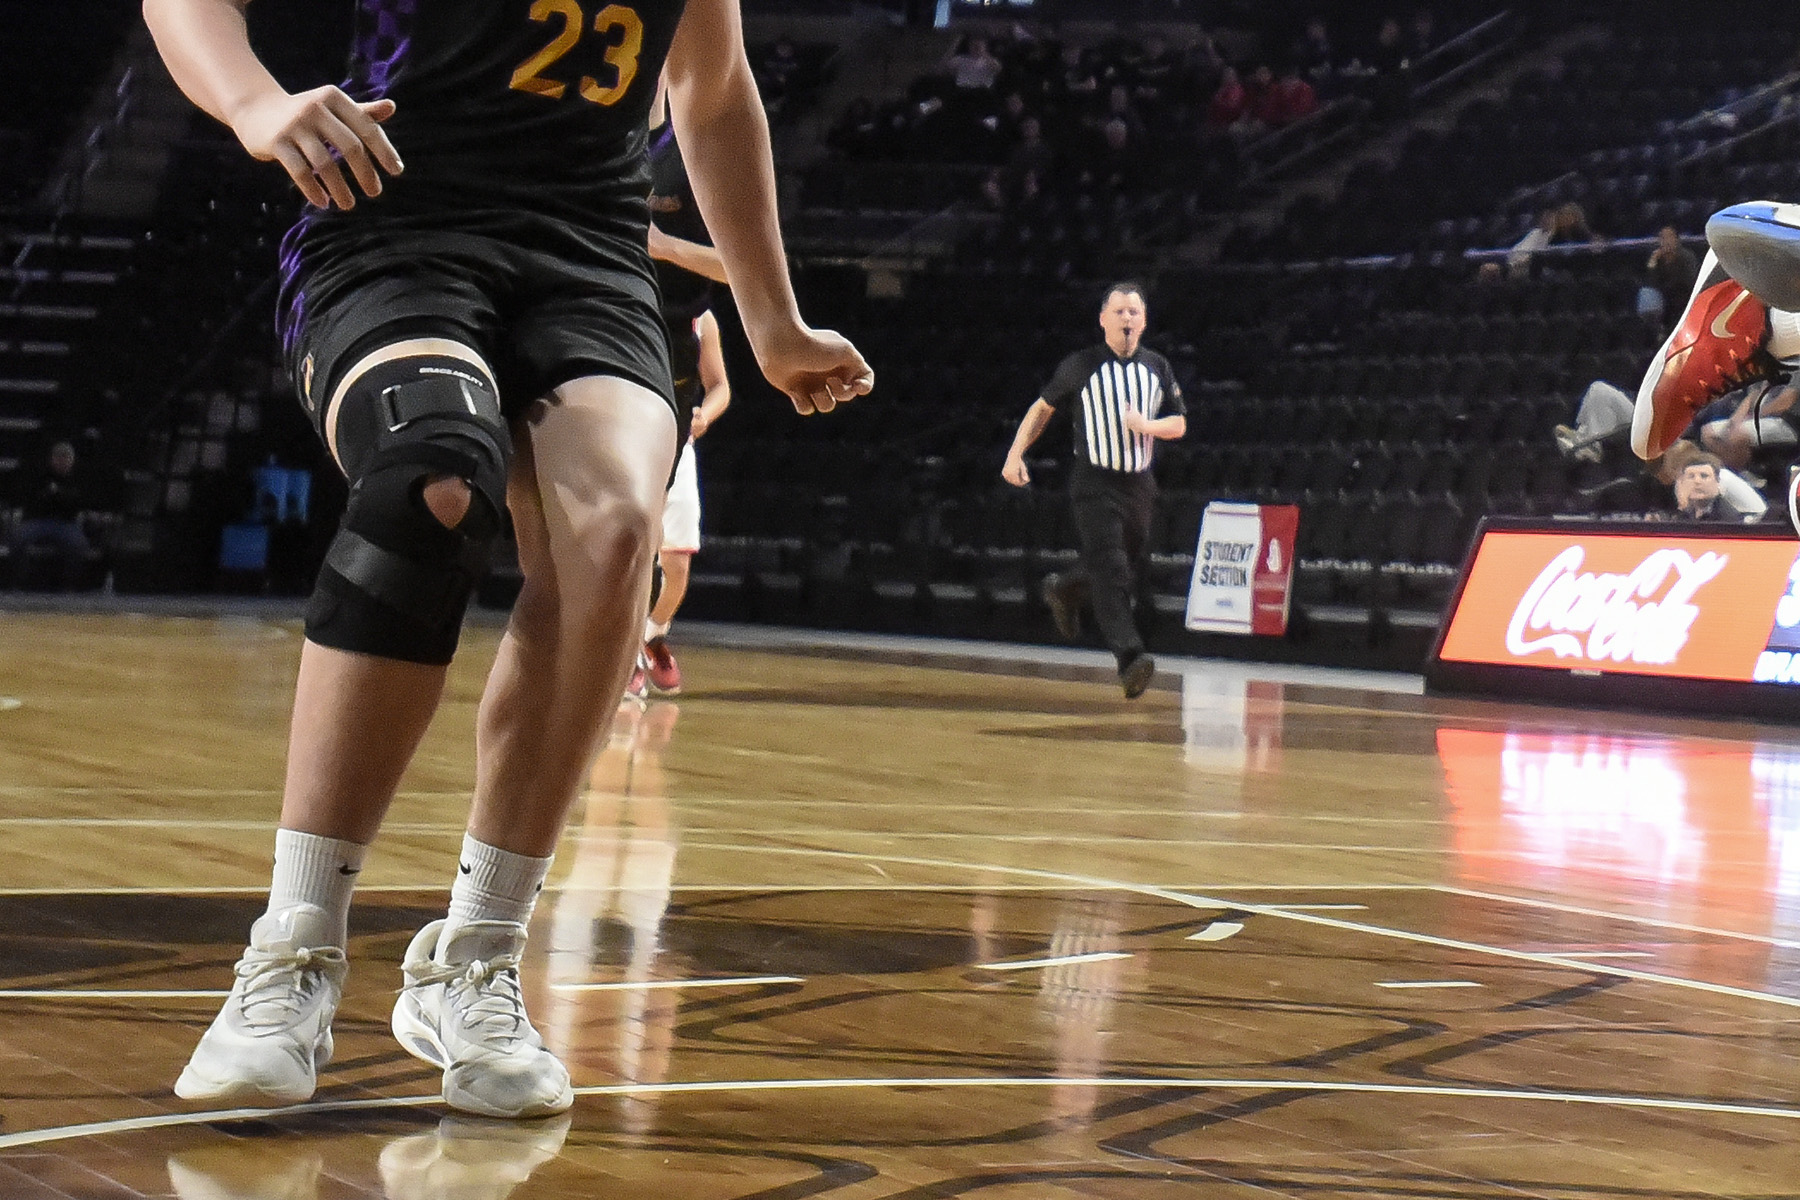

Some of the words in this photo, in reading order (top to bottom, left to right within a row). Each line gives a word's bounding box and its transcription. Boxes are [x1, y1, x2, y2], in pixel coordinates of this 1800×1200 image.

[1204, 541, 1254, 562] STUDENT
[1200, 564, 1248, 586] SECTION
[1505, 544, 1730, 665] Coca-Cola
